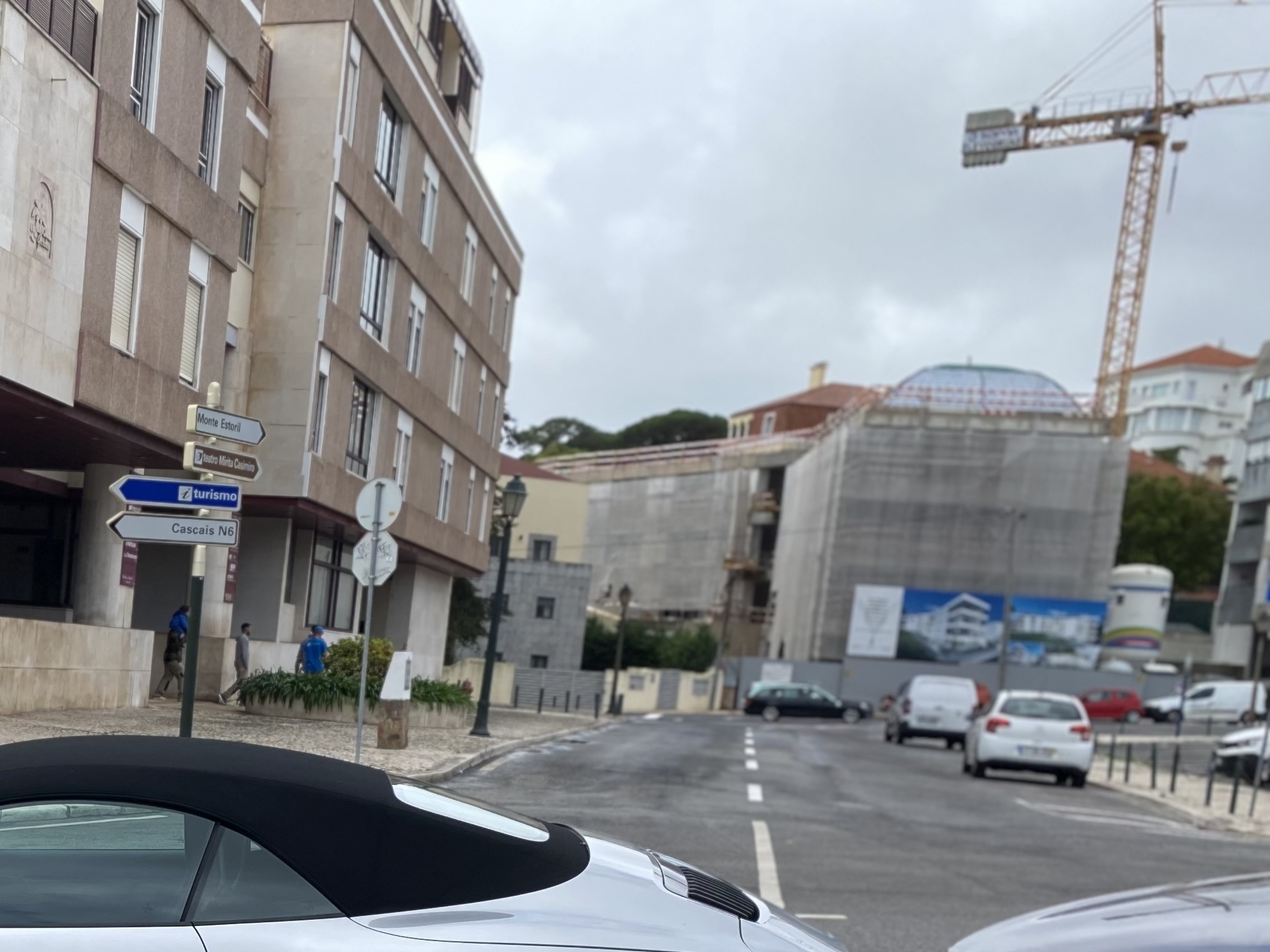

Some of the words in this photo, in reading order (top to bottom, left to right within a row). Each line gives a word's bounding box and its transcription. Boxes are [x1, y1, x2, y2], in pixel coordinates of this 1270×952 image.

[197, 412, 219, 428] Monte
[220, 418, 242, 433] Estoril
[194, 488, 238, 502] turismo
[171, 522, 215, 536] Cascais
[218, 525, 234, 537] N6
